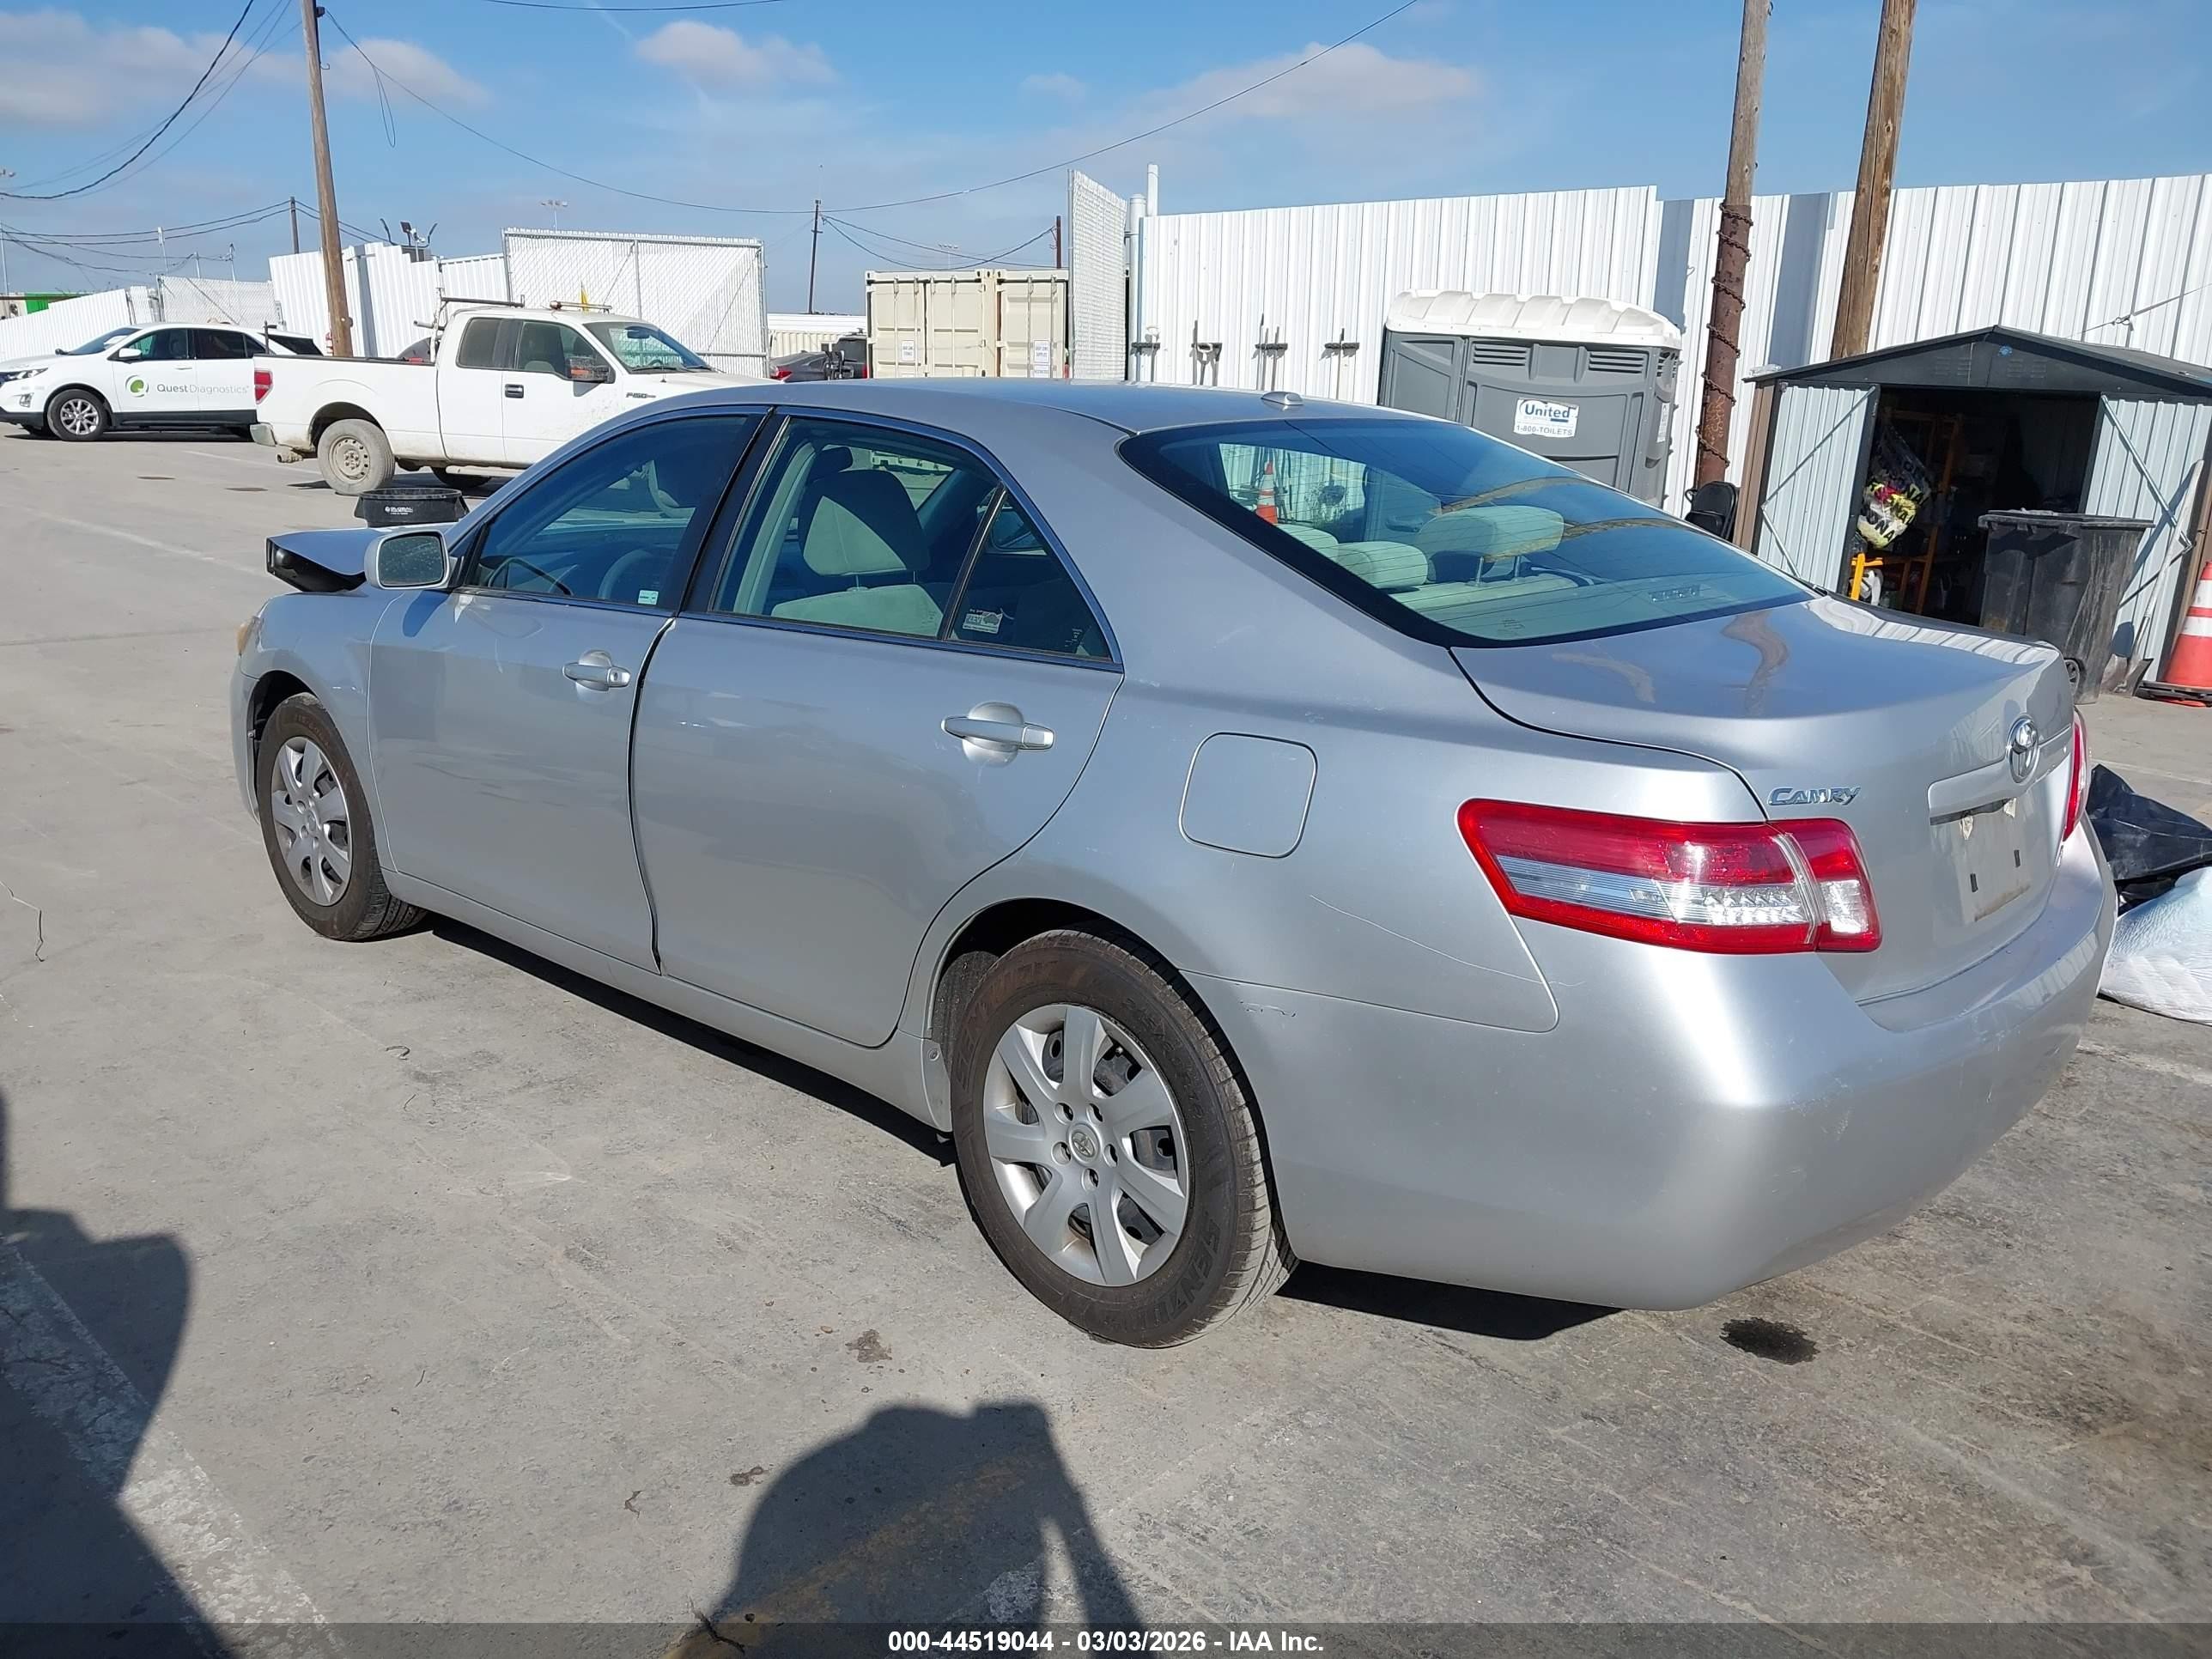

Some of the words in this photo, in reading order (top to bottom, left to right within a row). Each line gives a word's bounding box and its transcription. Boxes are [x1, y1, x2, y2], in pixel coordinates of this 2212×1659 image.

[156, 383, 189, 393] Quest
[1524, 403, 1571, 418] United
[1516, 424, 1573, 436] 1-800-TOILETS
[1767, 787, 1862, 806] CAMRY
